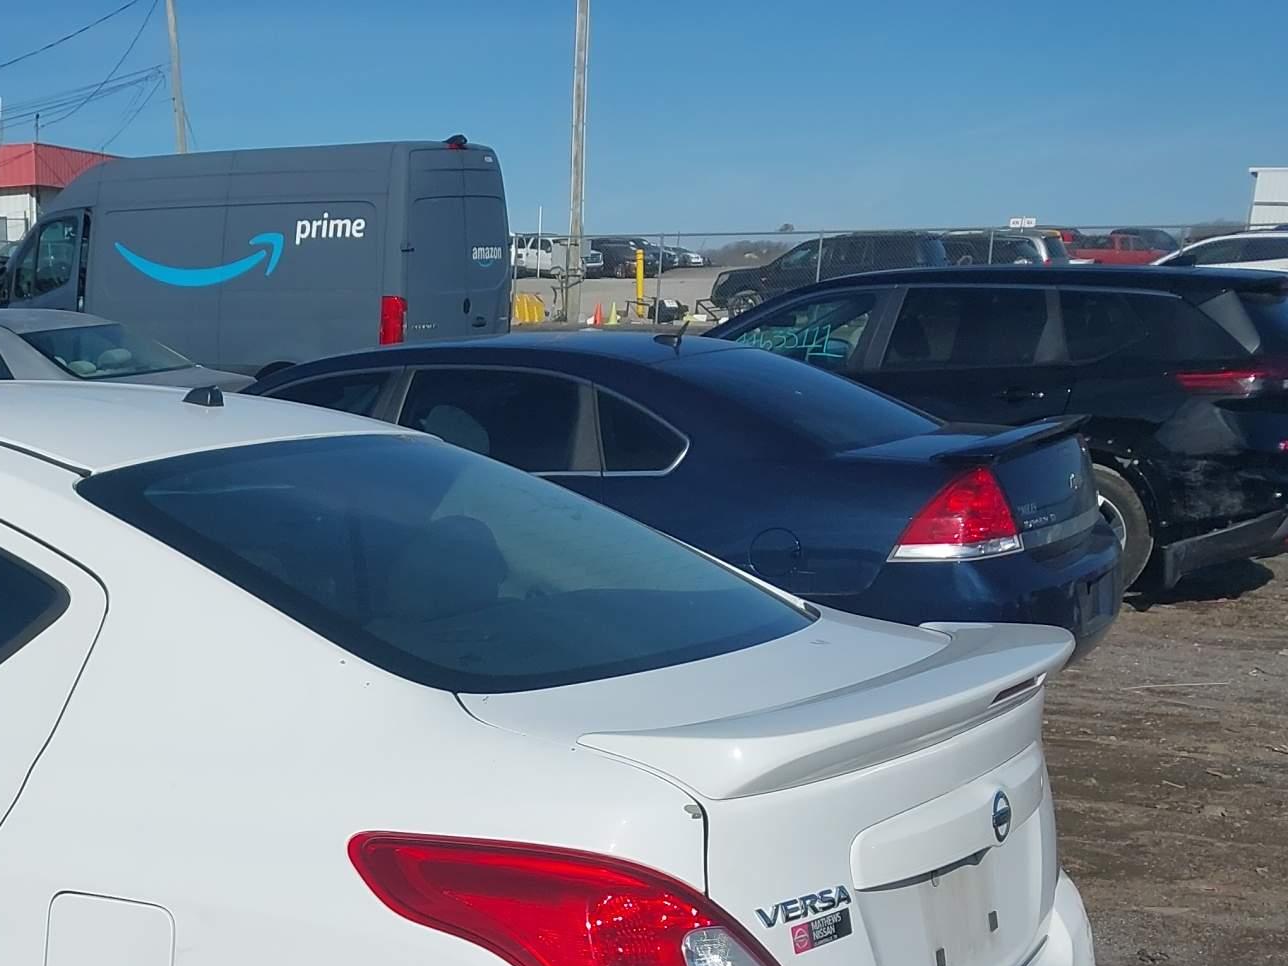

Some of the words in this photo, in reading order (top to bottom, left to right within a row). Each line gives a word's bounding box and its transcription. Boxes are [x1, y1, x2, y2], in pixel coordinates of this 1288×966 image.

[295, 212, 366, 245] prime
[472, 246, 502, 260] amazon
[753, 885, 852, 928] VERSA
[810, 912, 842, 931] MATHEWS
[812, 924, 836, 941] NISSAN
